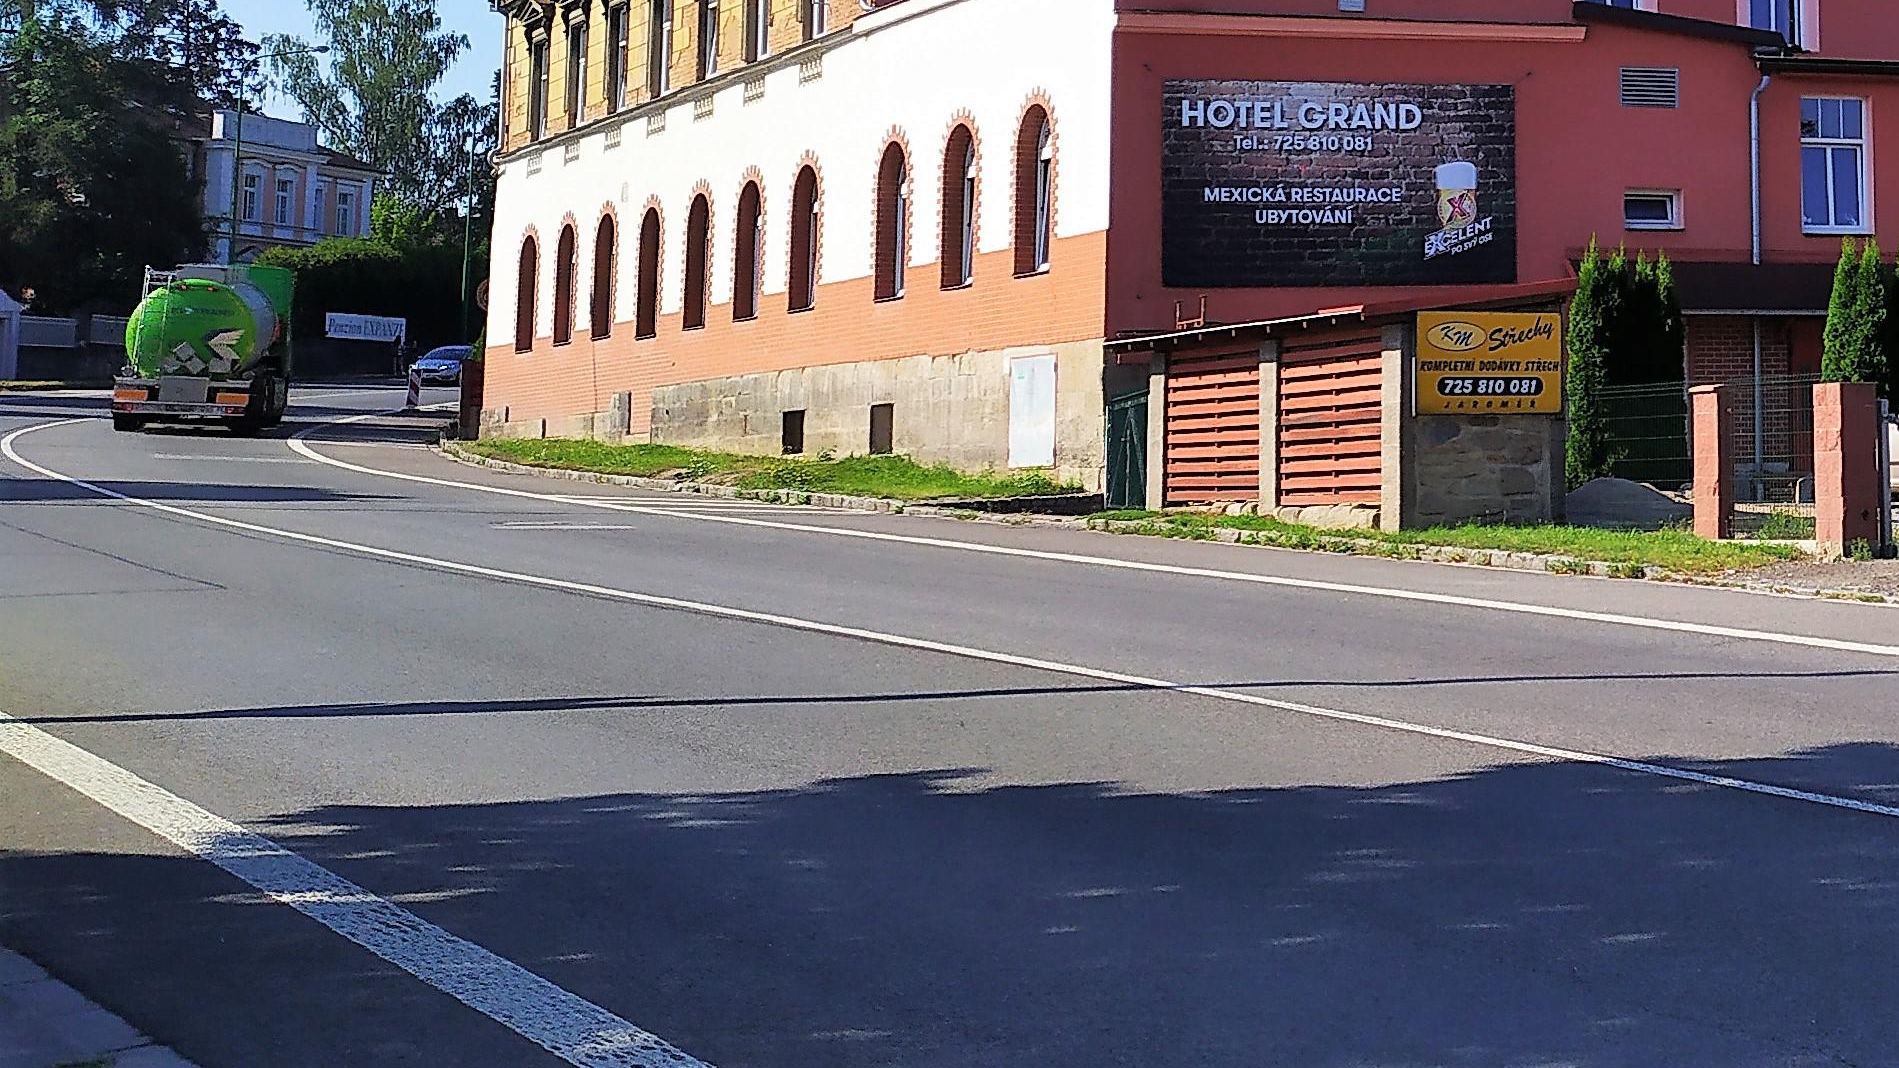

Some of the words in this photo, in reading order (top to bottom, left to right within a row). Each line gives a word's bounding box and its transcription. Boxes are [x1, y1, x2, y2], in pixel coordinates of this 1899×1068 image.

[1181, 99, 1289, 128] HOTEL
[1299, 103, 1423, 130] GRAND
[1233, 135, 1269, 151] Tel.:
[1273, 136, 1311, 151] 725
[1311, 136, 1339, 151] 810
[1343, 137, 1373, 151] 081
[1203, 184, 1286, 203] MEXICKÁ
[1290, 188, 1402, 203] RESTAURACE
[1255, 206, 1353, 225] UBYTOVÁNÍ
[1424, 216, 1493, 257] EXCELENT
[1451, 244, 1463, 256] PO
[1440, 325, 1474, 347] KM
[1488, 316, 1554, 352] Střechy
[1420, 358, 1476, 372] KOMPLETNÍ
[1478, 358, 1521, 372] DODÁVKY
[1524, 357, 1560, 372] STŘECH
[1444, 379, 1474, 394] 725
[1477, 379, 1505, 394] 810
[1509, 379, 1537, 394] 081
